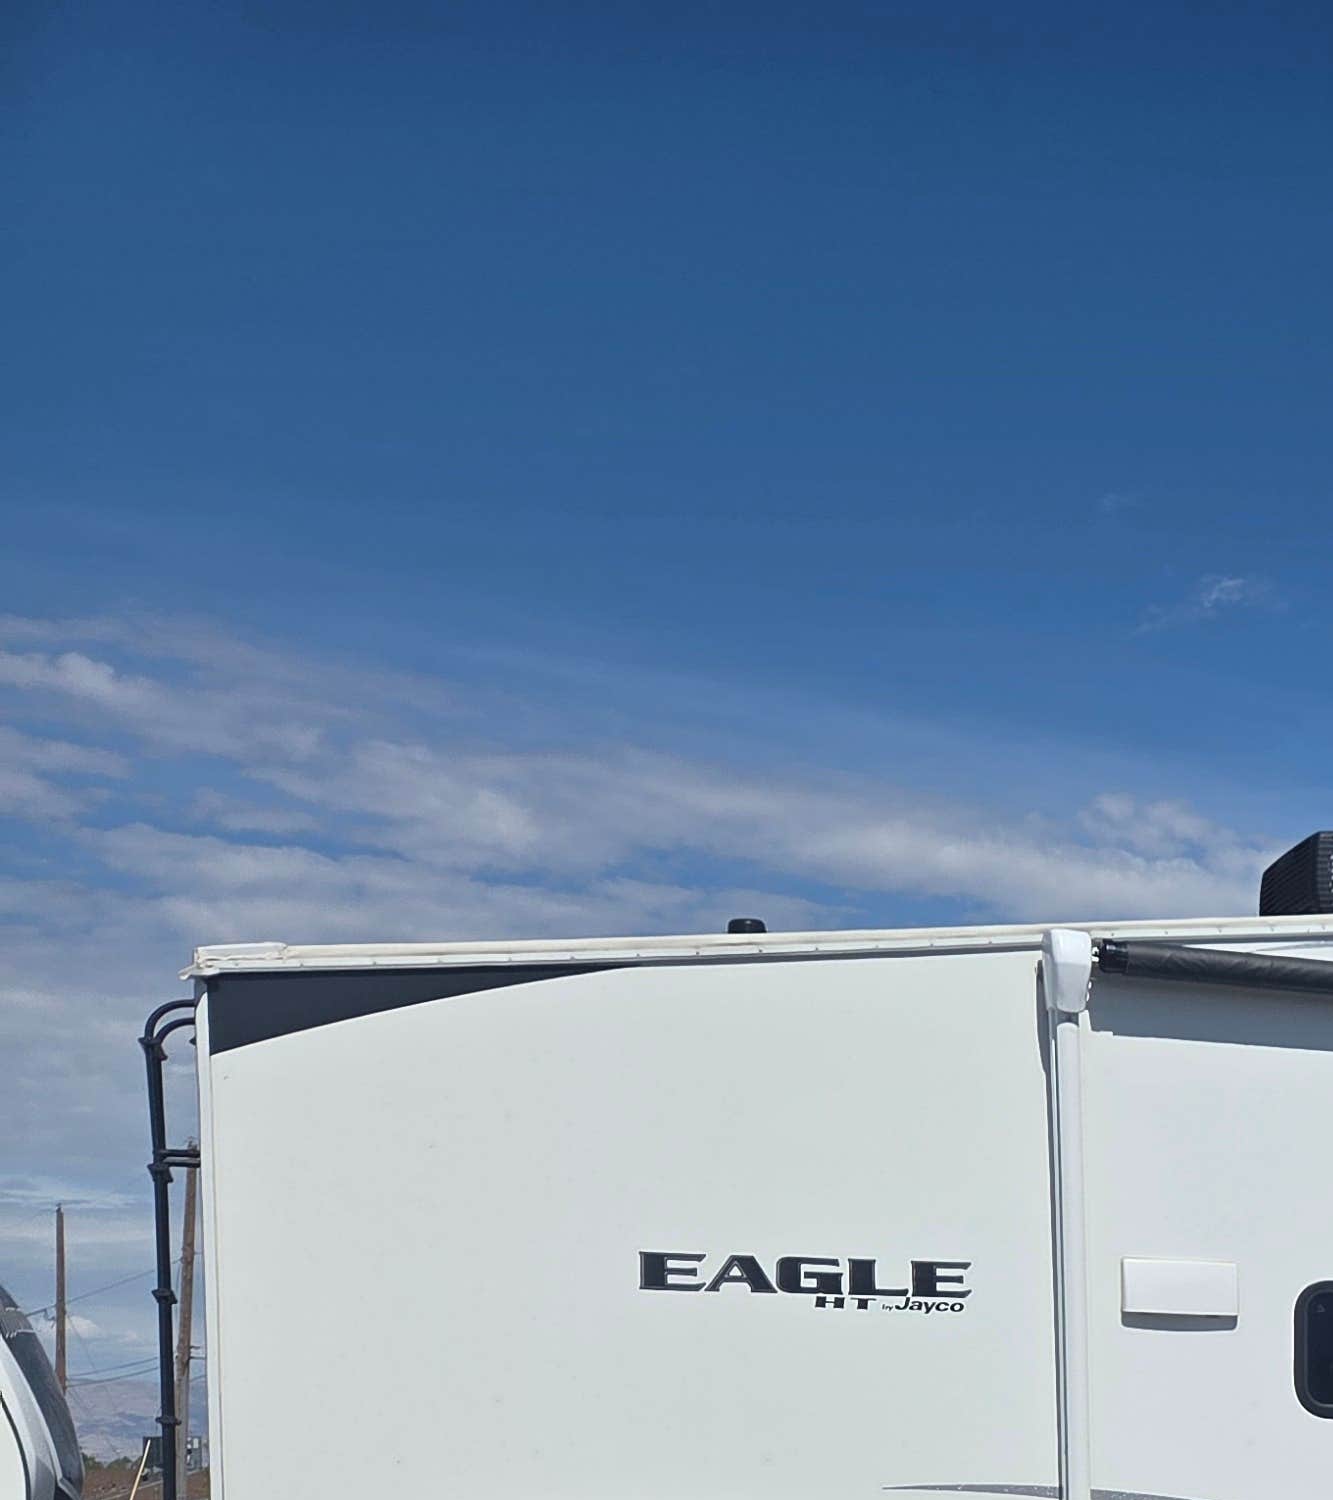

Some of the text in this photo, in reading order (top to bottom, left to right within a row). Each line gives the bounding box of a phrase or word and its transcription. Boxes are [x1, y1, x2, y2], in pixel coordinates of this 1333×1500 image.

[638, 1251, 973, 1298] EAGLE
[814, 1296, 877, 1310] HT
[895, 1296, 965, 1314] Jayco
